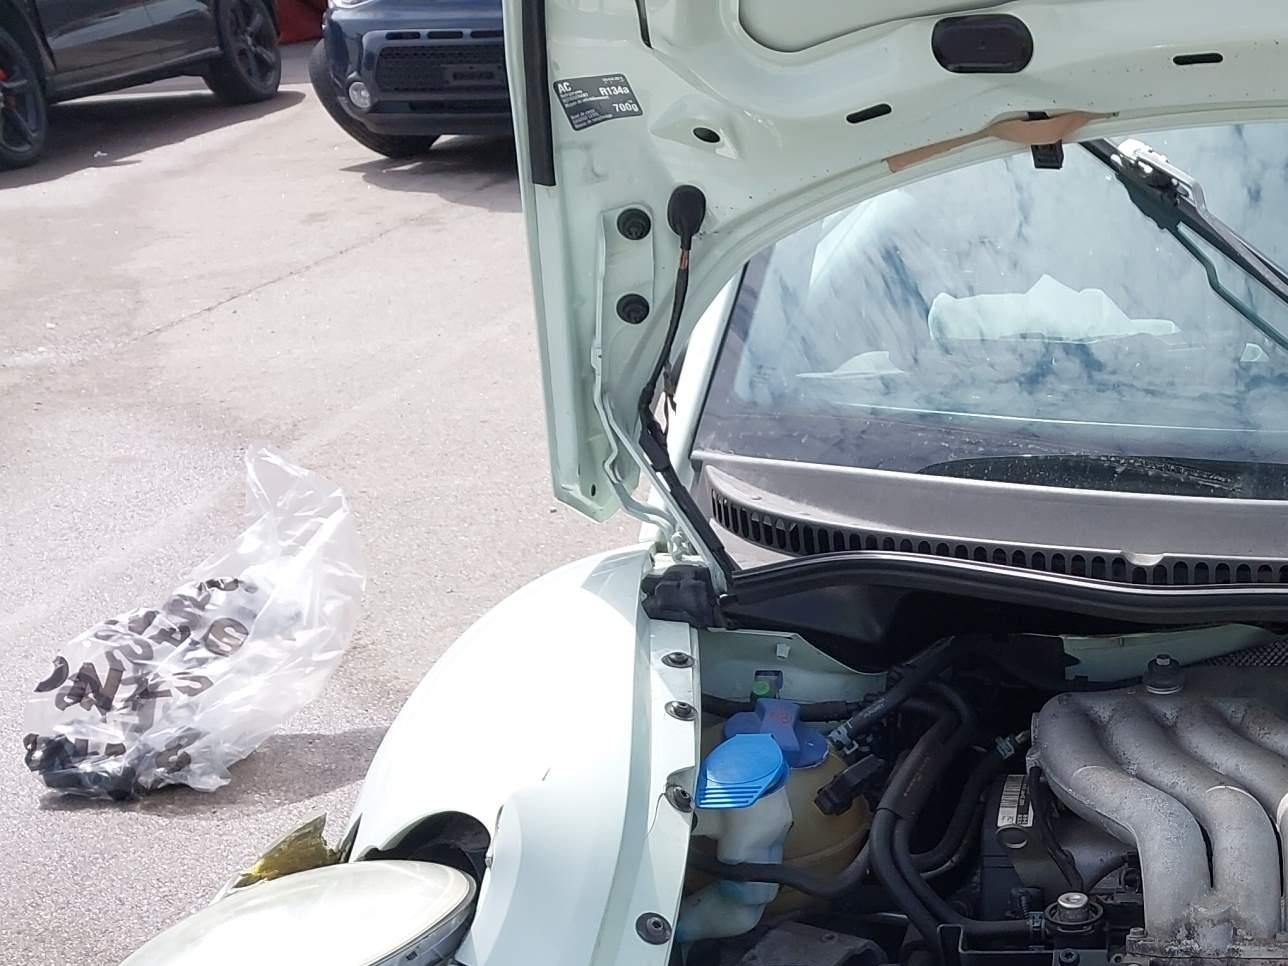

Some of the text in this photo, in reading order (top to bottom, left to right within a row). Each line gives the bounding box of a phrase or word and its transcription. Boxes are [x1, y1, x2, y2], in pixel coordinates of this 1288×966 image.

[558, 82, 572, 93] AC
[599, 86, 630, 96] R134a
[612, 102, 638, 112] 700g
